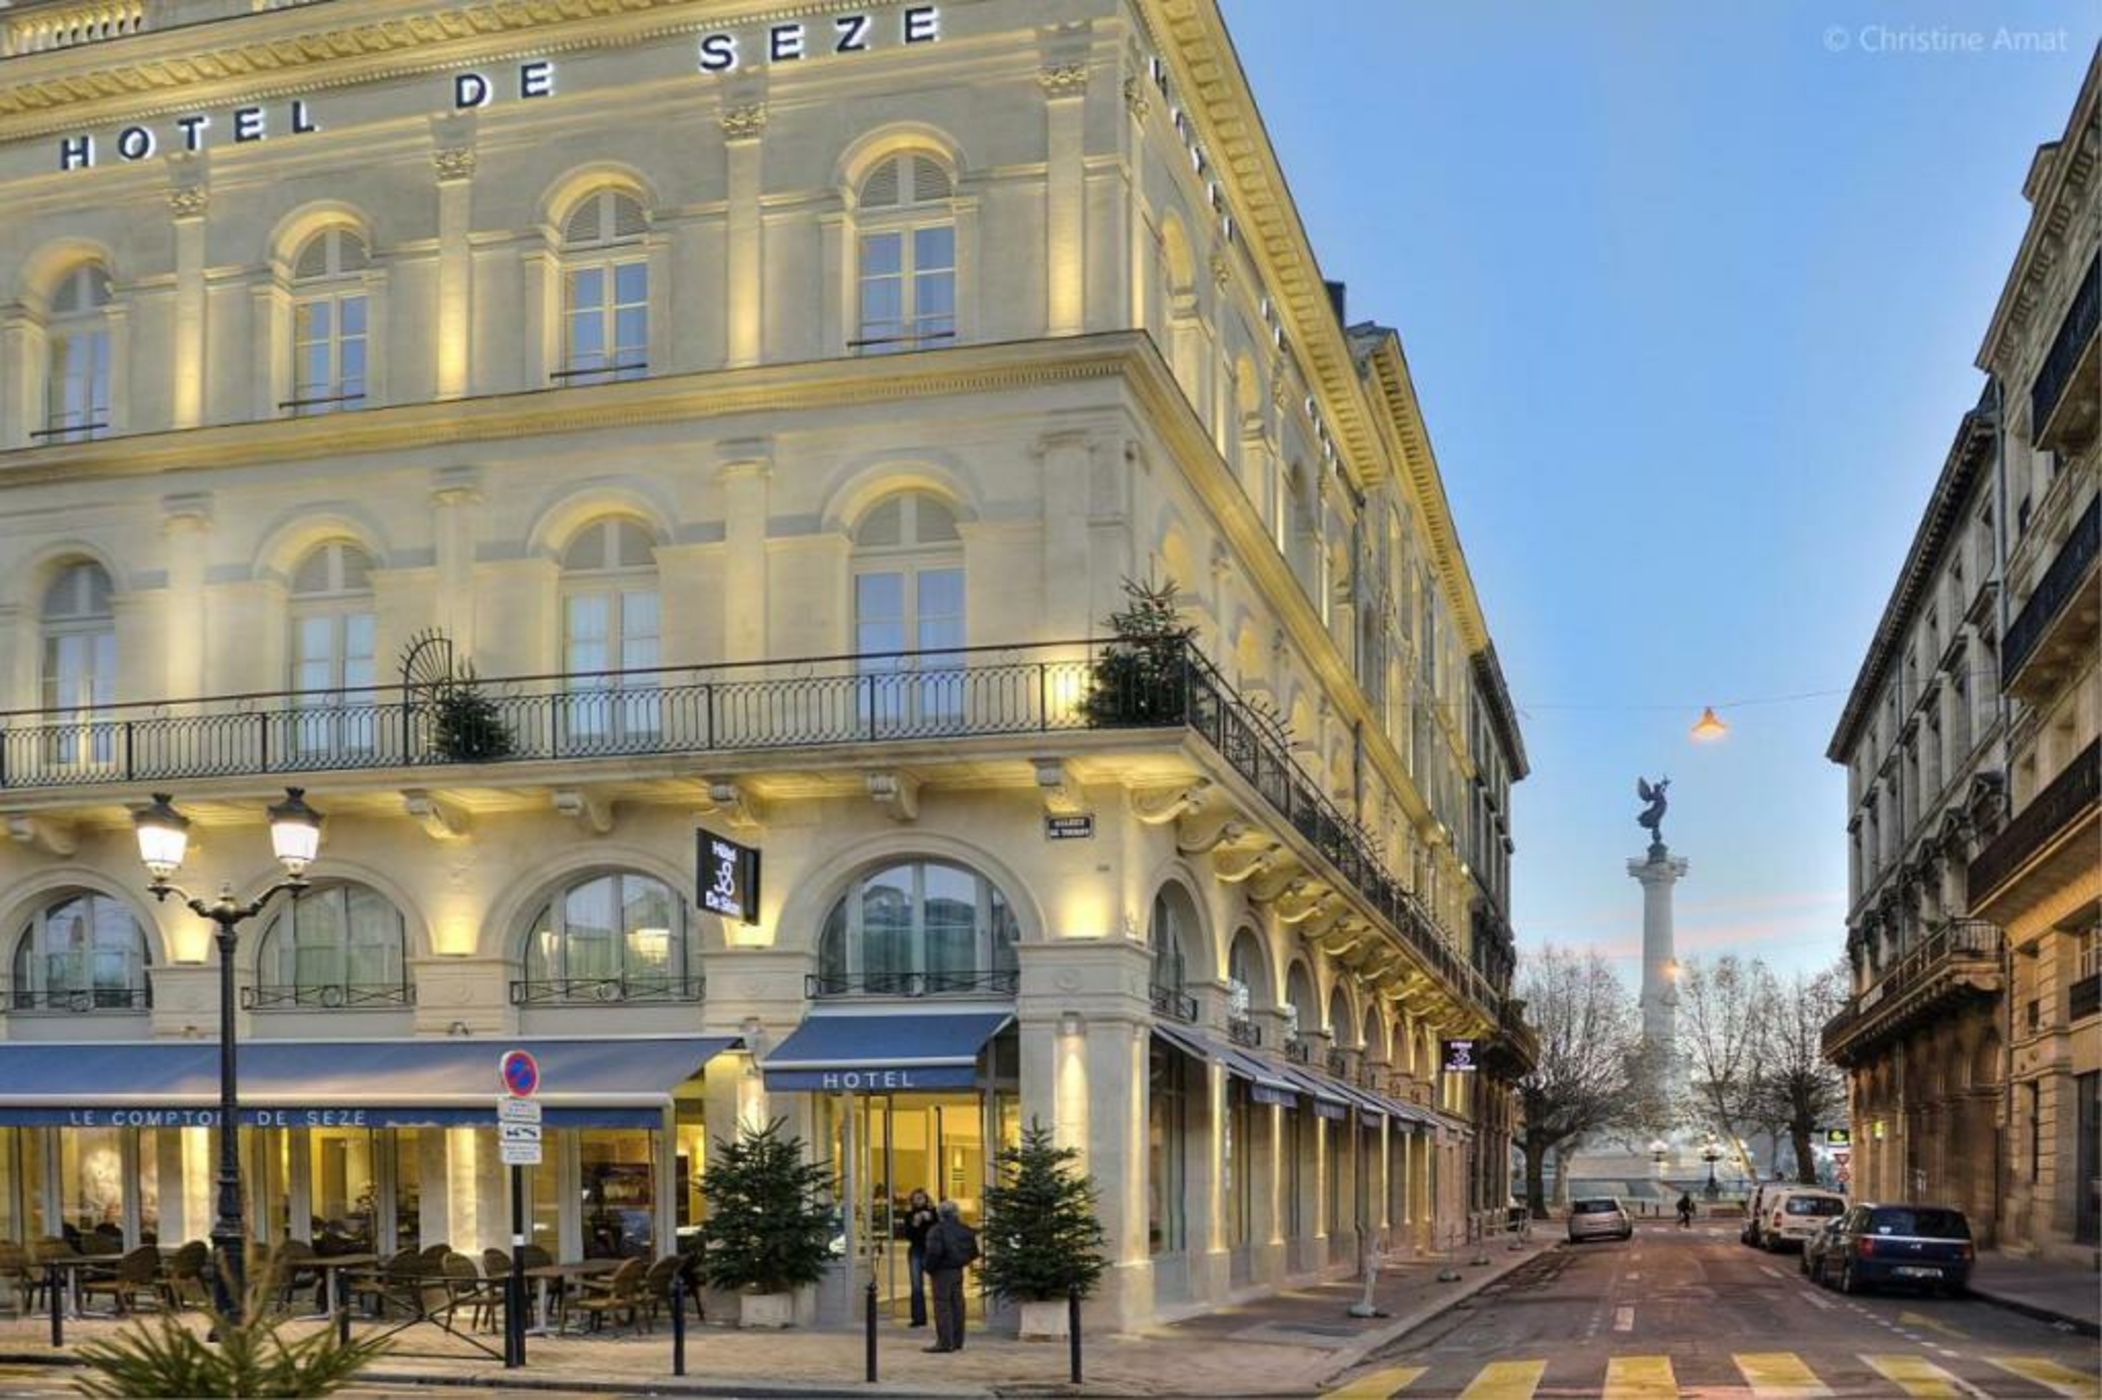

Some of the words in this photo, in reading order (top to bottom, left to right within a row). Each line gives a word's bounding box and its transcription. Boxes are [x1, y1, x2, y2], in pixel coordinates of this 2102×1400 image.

[60, 101, 317, 171] HOTEL
[455, 62, 553, 108] DE
[700, 6, 939, 71] SEZE
[823, 1071, 914, 1088] HOTEL
[70, 1111, 95, 1126] LE
[112, 1110, 222, 1126] COMPTOI
[257, 1110, 288, 1126] DE
[306, 1110, 366, 1126] SEZE
